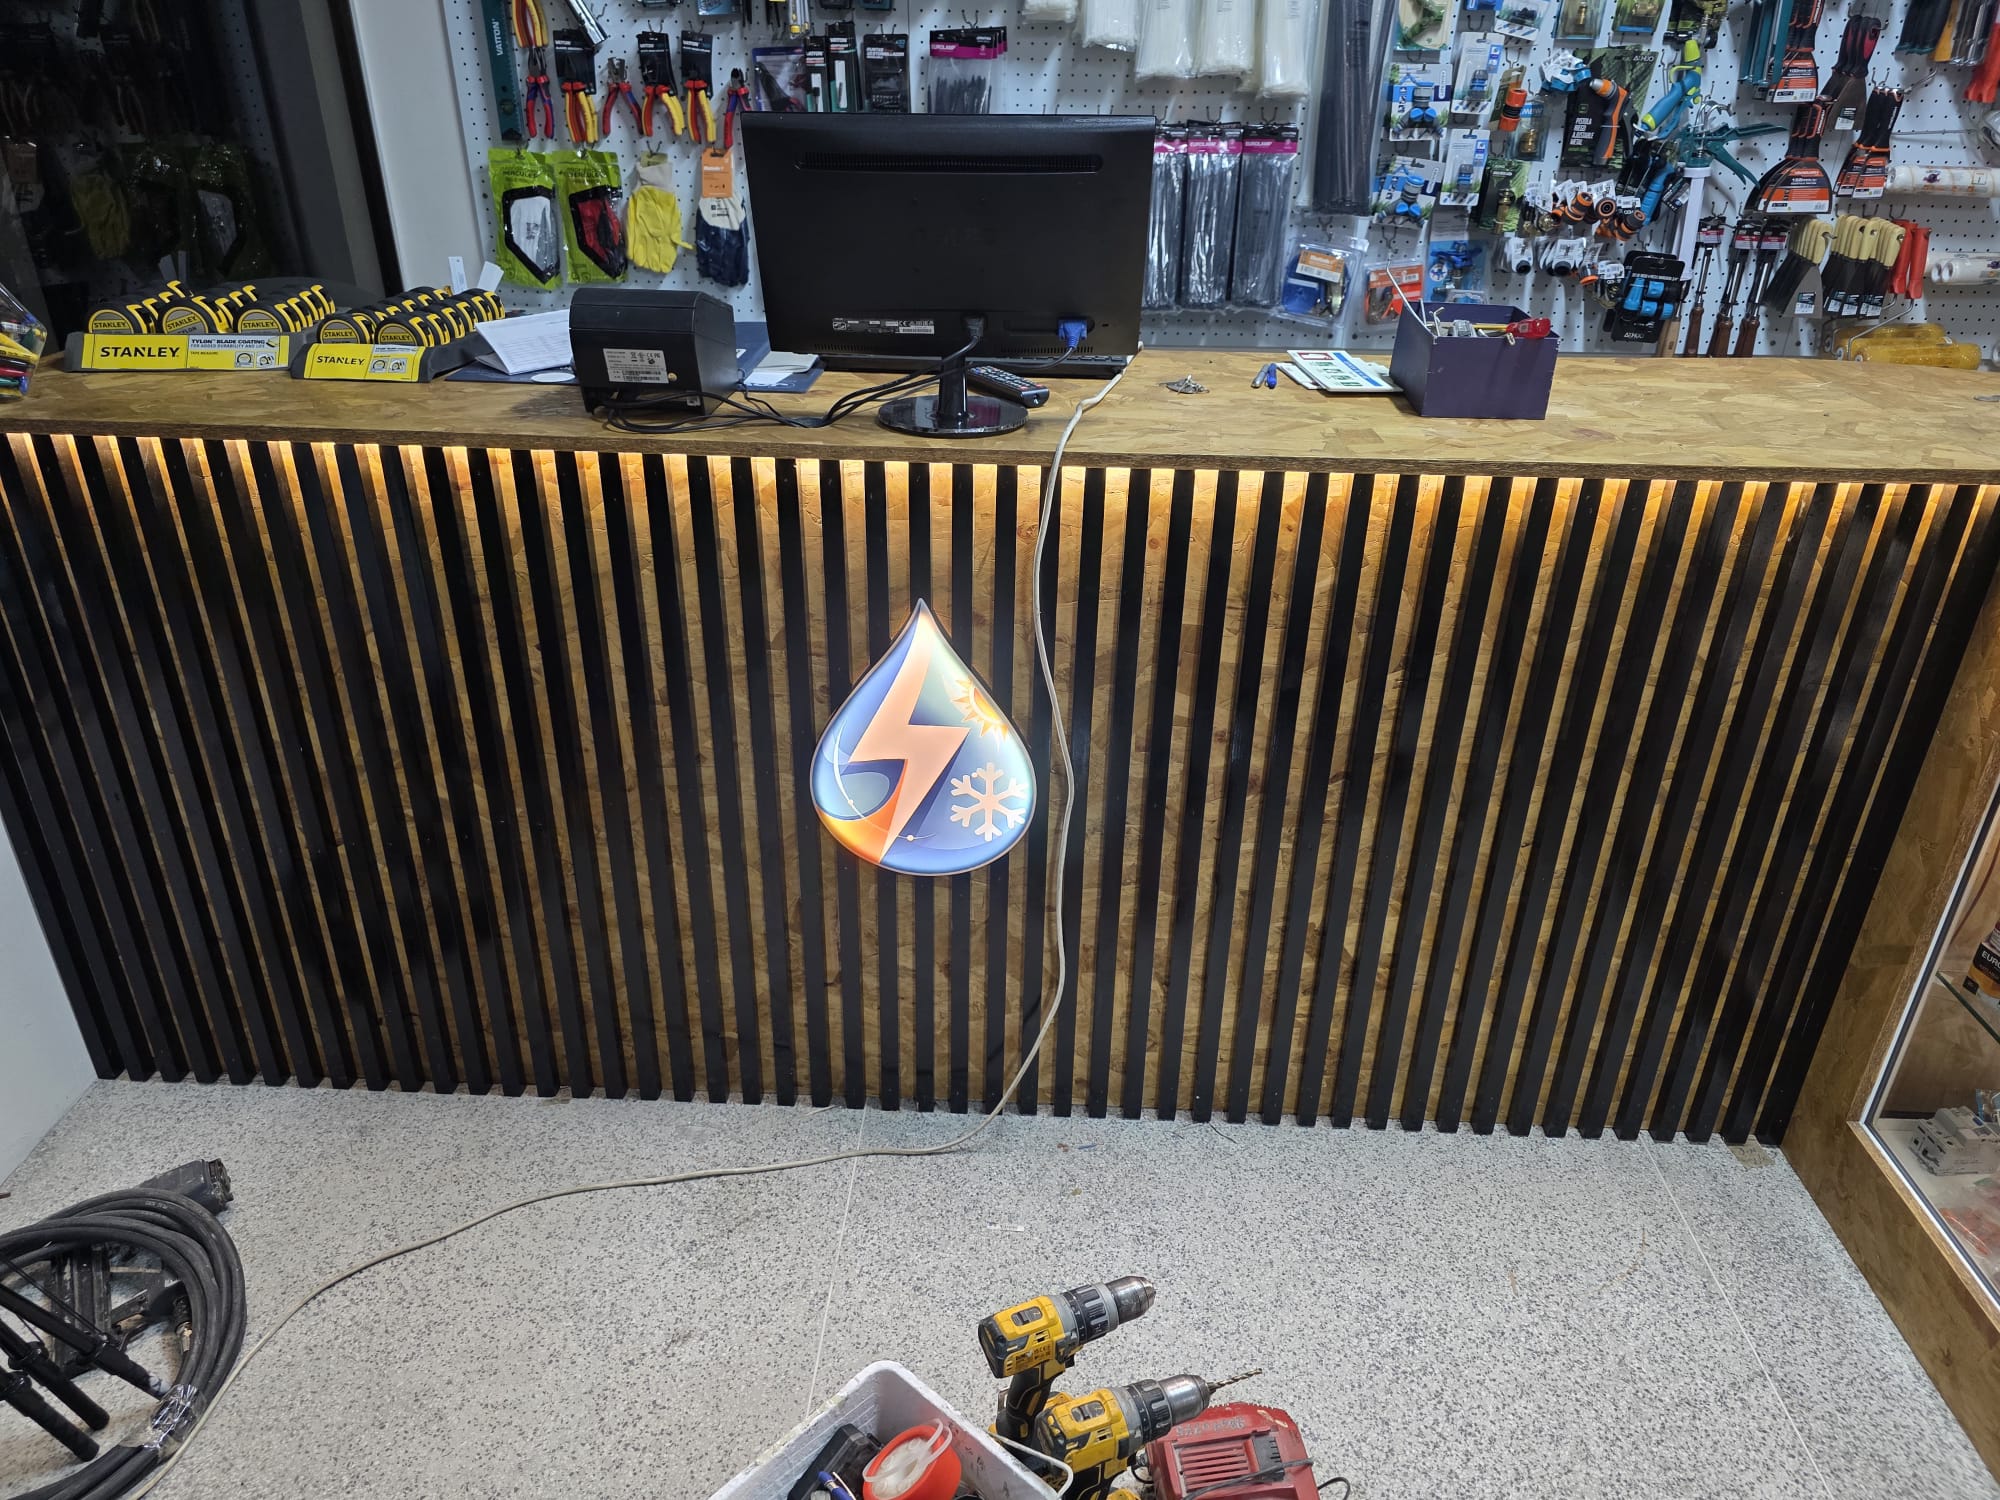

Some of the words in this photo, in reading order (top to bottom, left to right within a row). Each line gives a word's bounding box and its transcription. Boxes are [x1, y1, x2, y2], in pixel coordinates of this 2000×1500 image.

[93, 321, 127, 329] STANLEY
[167, 315, 198, 330] STANLEY
[242, 320, 276, 329] STANLEY
[100, 346, 180, 359] STANLEY
[316, 355, 366, 366] STANLEY
